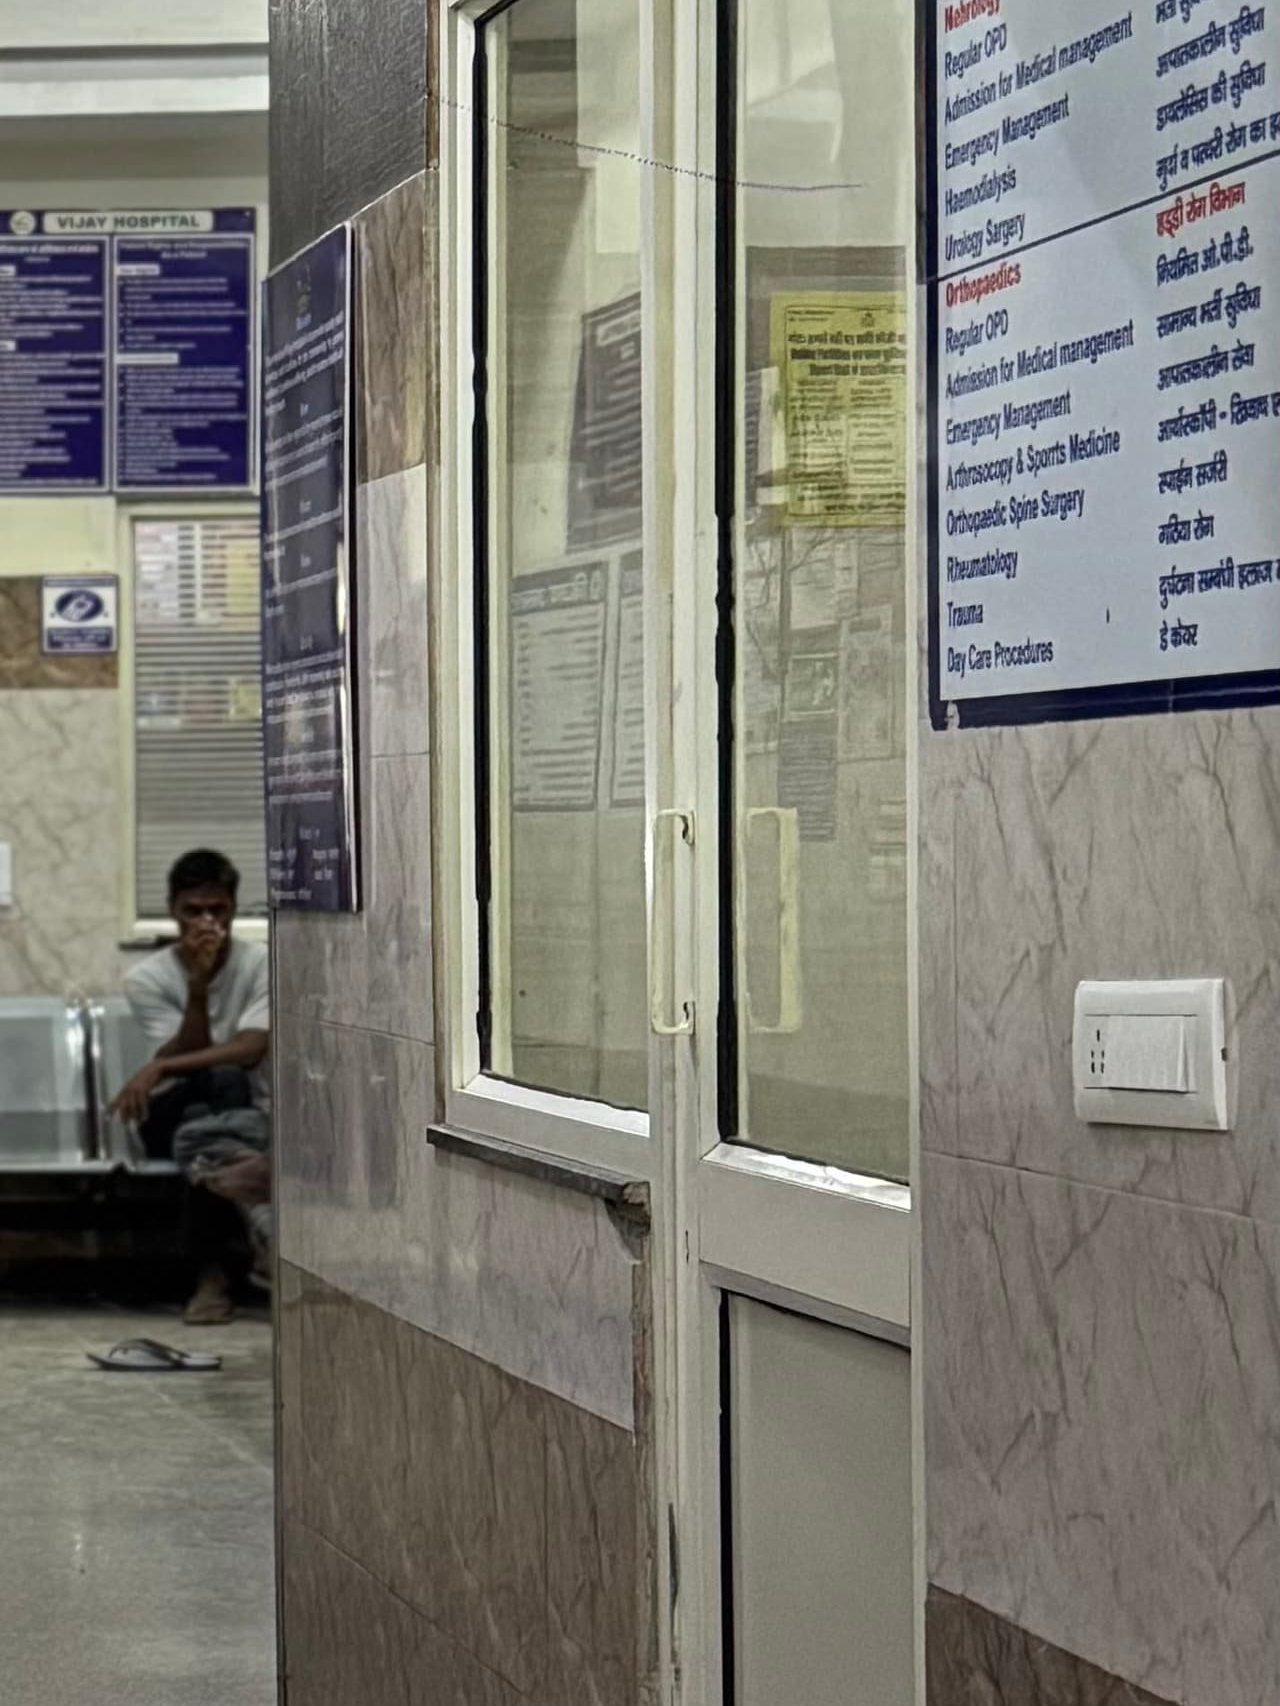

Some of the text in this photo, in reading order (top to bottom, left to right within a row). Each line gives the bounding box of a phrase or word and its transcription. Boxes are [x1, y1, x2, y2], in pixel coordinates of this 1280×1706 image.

[945, 24, 1007, 79] Regular OPD
[945, 11, 1133, 126] Admission for Medical management
[945, 92, 1070, 171] Emergency Management
[945, 166, 1018, 217] Haemodialysis
[57, 214, 201, 230] VIJAY HOSPITAL
[945, 229, 983, 262] Urology
[946, 261, 1021, 308] Orthopaedics
[946, 319, 984, 357] Regular
[986, 308, 1009, 343] OPD
[946, 318, 1134, 400] Admission for Medical management
[946, 389, 1072, 447] Emergency Management
[1016, 447, 1025, 475] &
[1068, 426, 1121, 465] Medicine
[947, 489, 1086, 538] Orthopaedic Spine Surgery
[947, 548, 1019, 583] Rheumatology
[947, 601, 984, 629] Trauma
[947, 636, 1055, 678] Day Care Procedures
